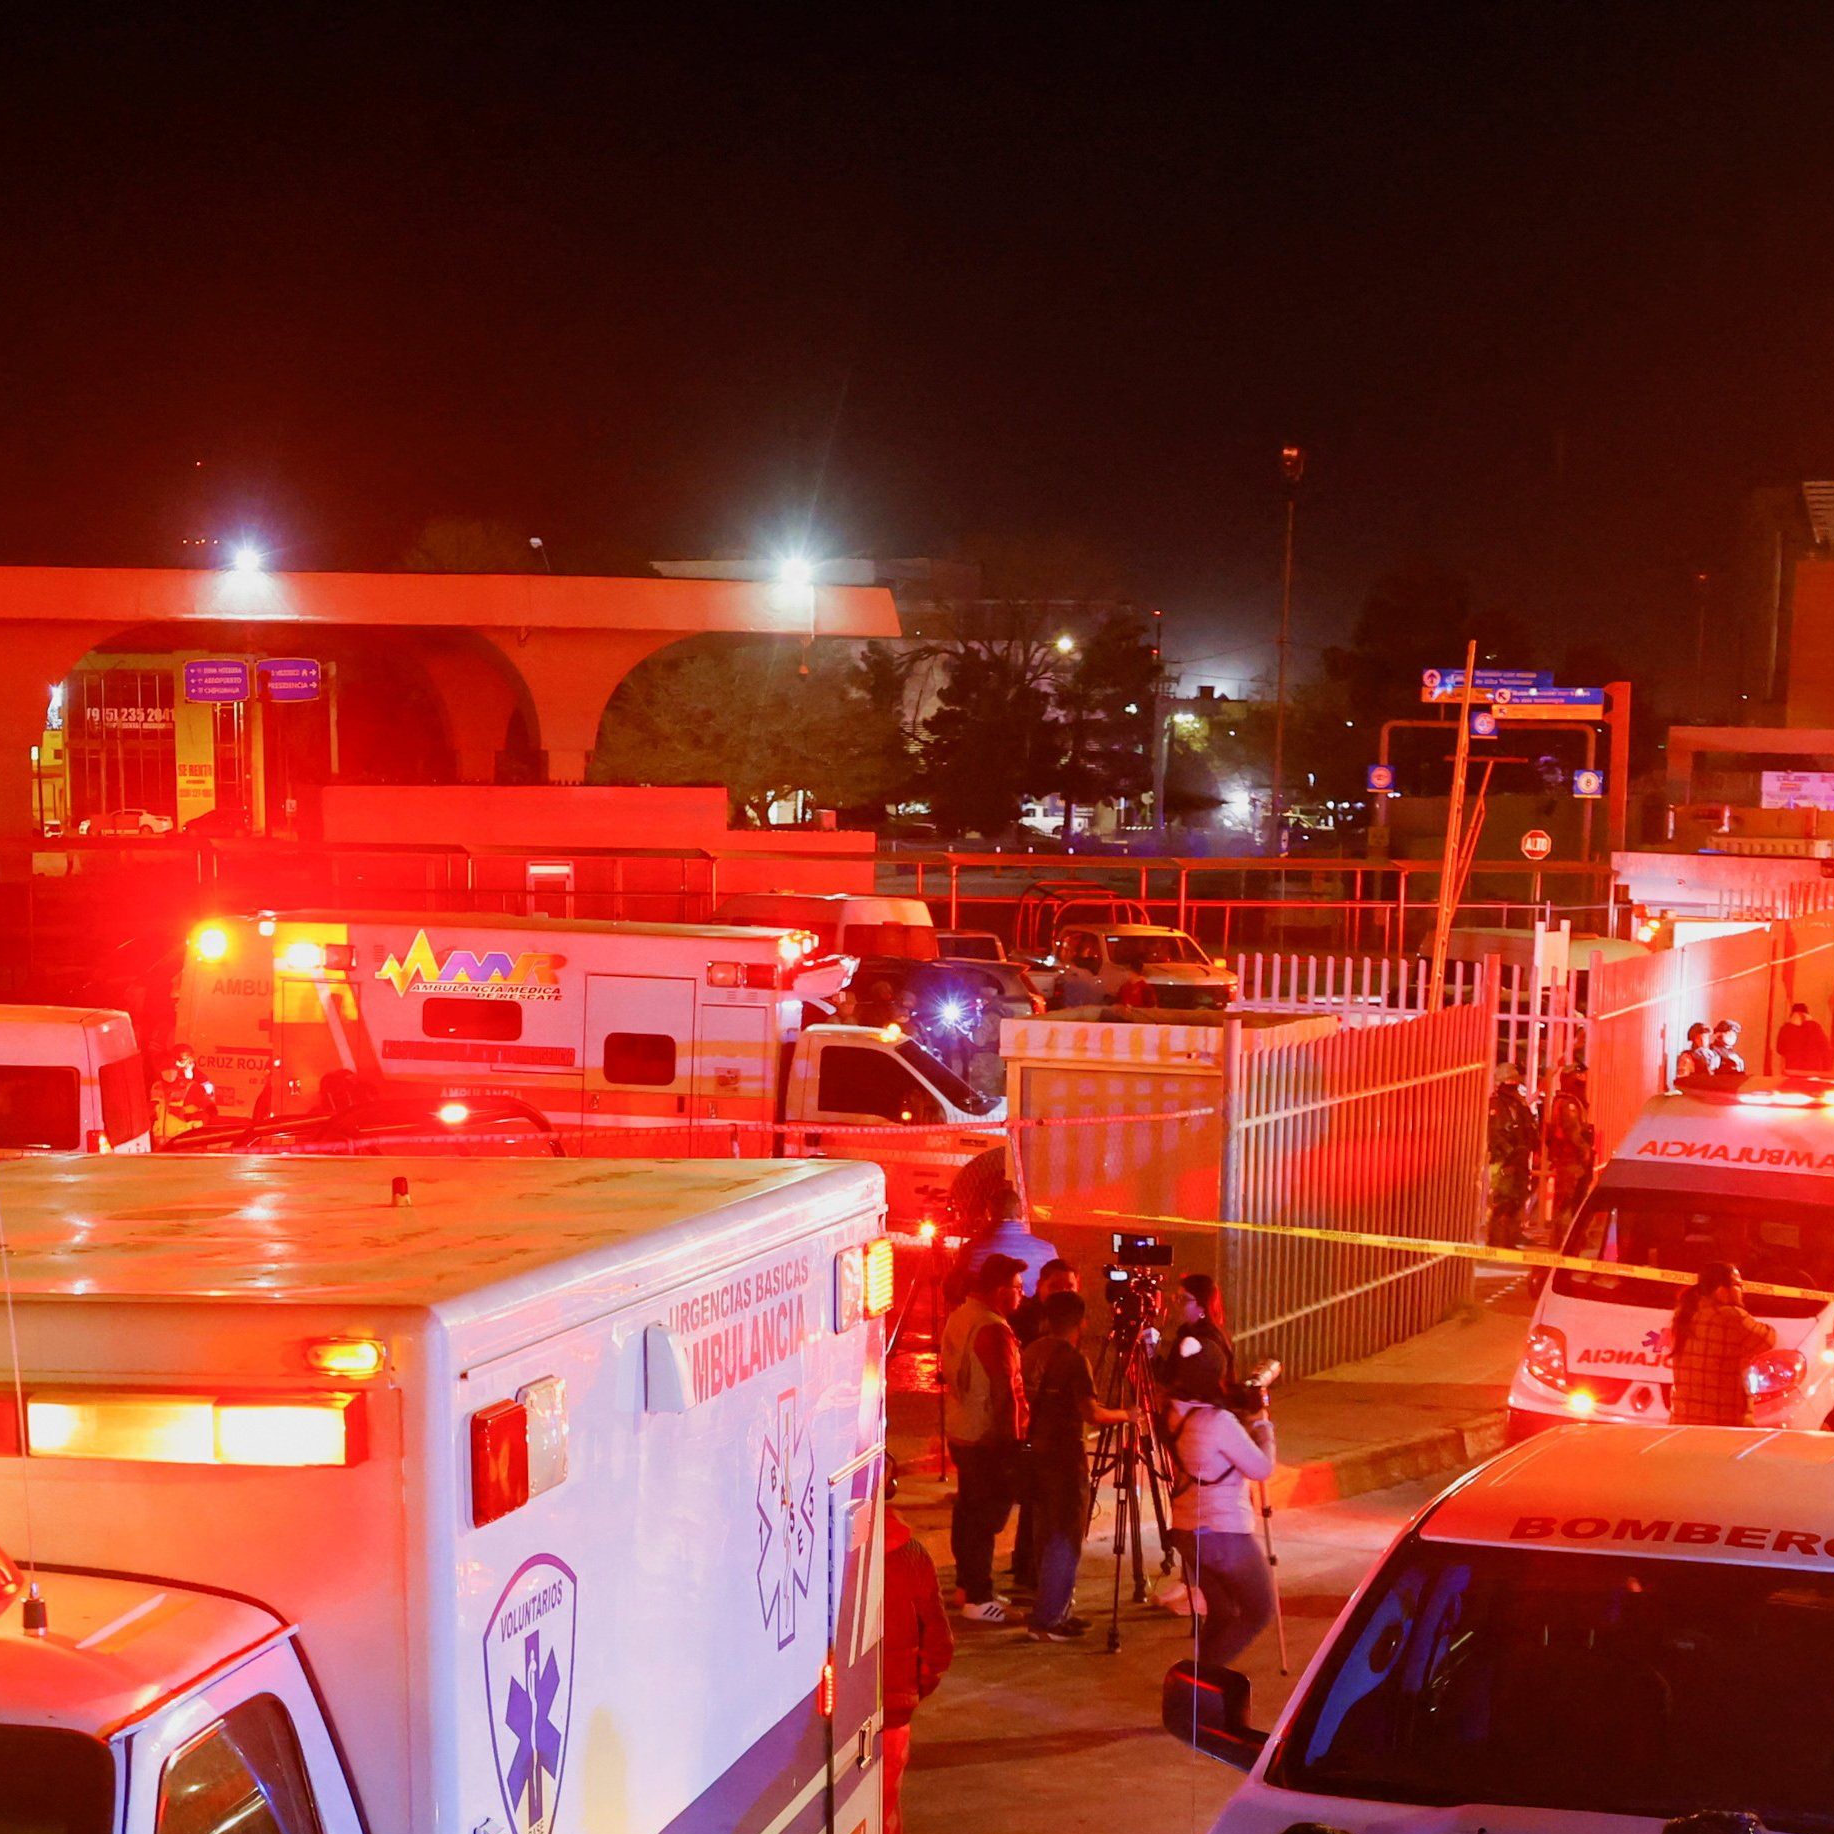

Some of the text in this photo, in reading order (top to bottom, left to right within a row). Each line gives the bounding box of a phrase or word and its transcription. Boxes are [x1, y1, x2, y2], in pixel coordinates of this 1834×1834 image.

[121, 707, 145, 723] 235
[1525, 837, 1549, 851] ALTO
[412, 983, 561, 995] AMBULANCIA MEDICA
[498, 993, 563, 1001] RESCATE
[198, 1056, 233, 1069] CRUZ
[670, 1256, 809, 1335] URGENCIAS BASICAS
[685, 1294, 805, 1403] MBULANCIA
[500, 1579, 564, 1643] VOLUNTARIOS
